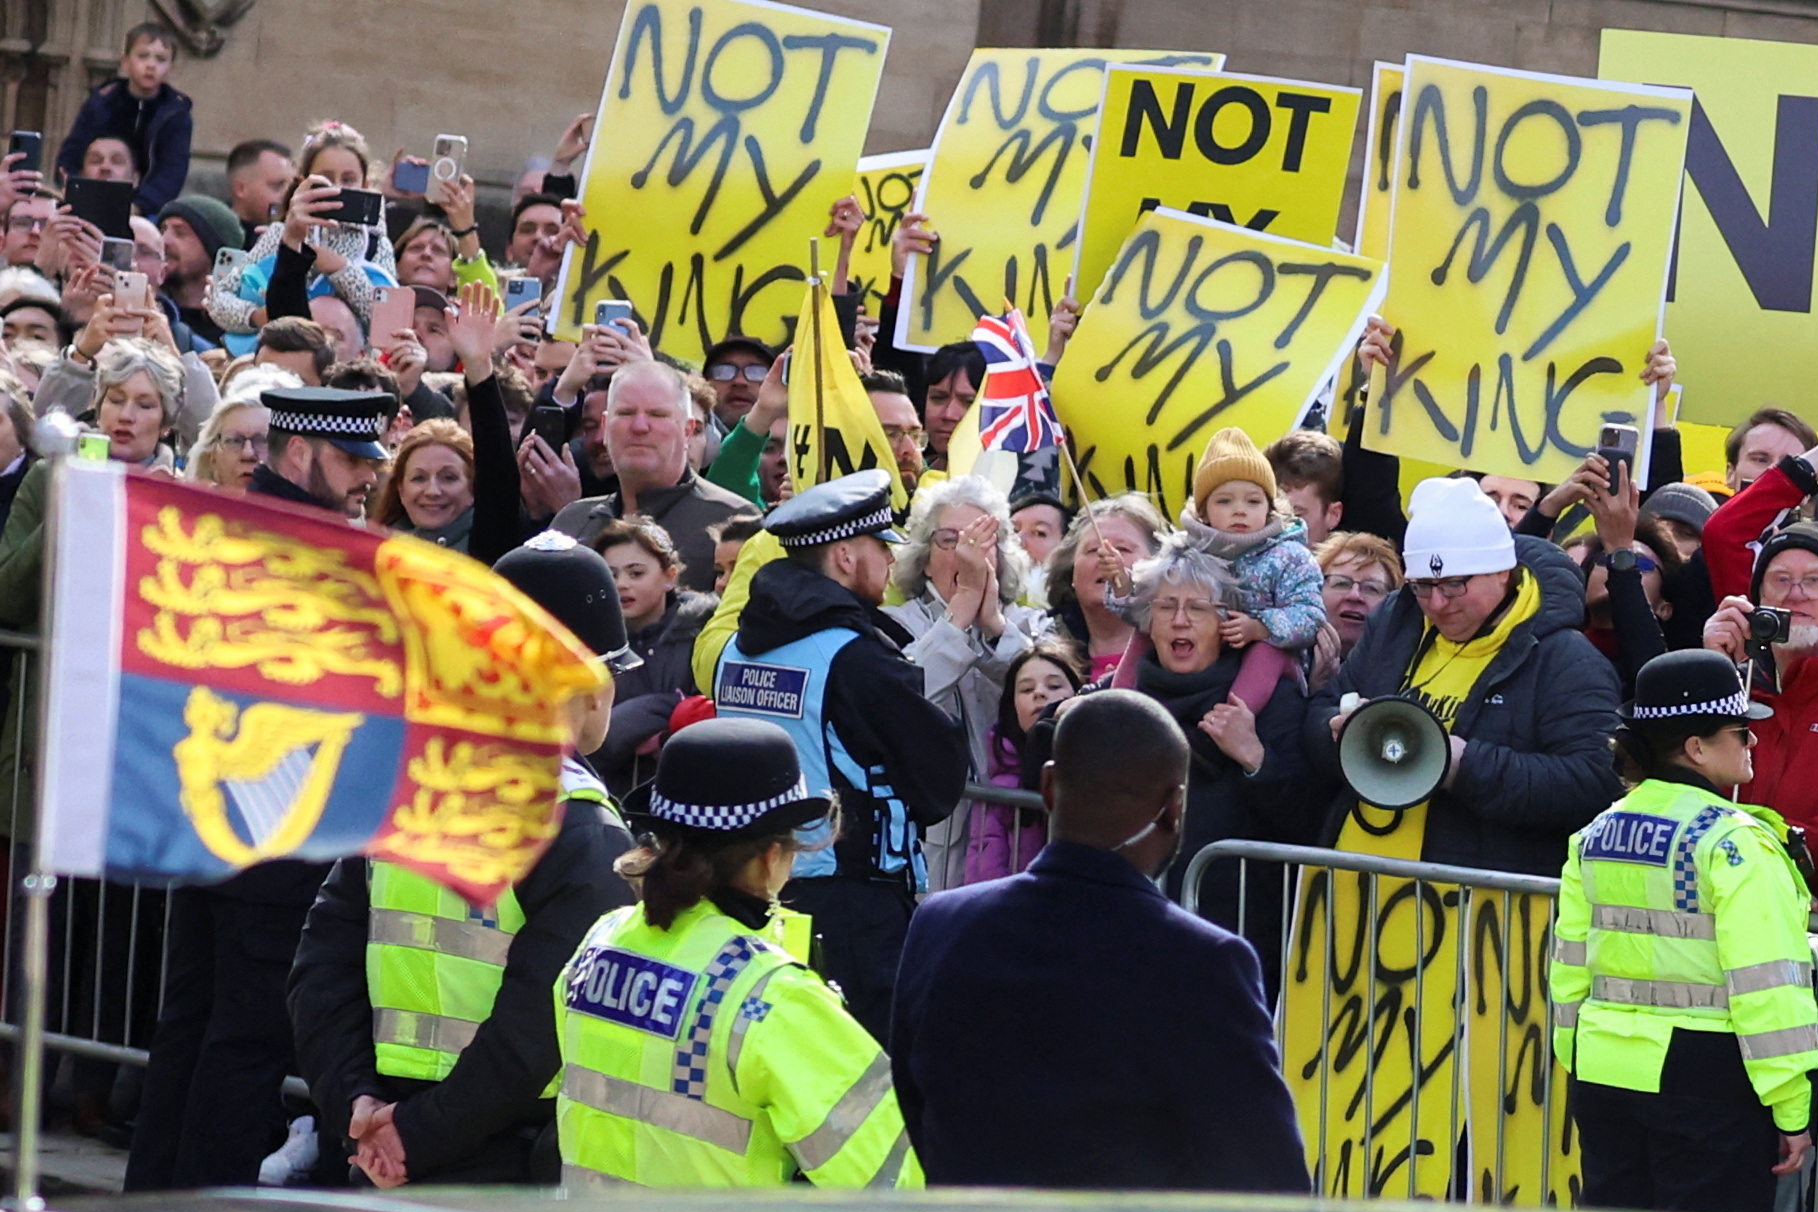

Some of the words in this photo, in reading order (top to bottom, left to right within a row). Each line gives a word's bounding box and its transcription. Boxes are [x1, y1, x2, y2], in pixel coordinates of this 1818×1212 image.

[618, 3, 878, 144] NOT
[1119, 78, 1332, 173] NOT
[630, 112, 822, 263] MY
[1407, 83, 1682, 228] NOT
[1100, 229, 1373, 350] NOT
[1430, 202, 1632, 362] MY
[1094, 321, 1291, 452] MY
[1378, 327, 1638, 465] KING
[720, 685, 756, 705] LIAISON
[756, 689, 799, 711] OFFICER
[741, 668, 778, 688] POLICE
[1303, 983, 1466, 1146] MY
